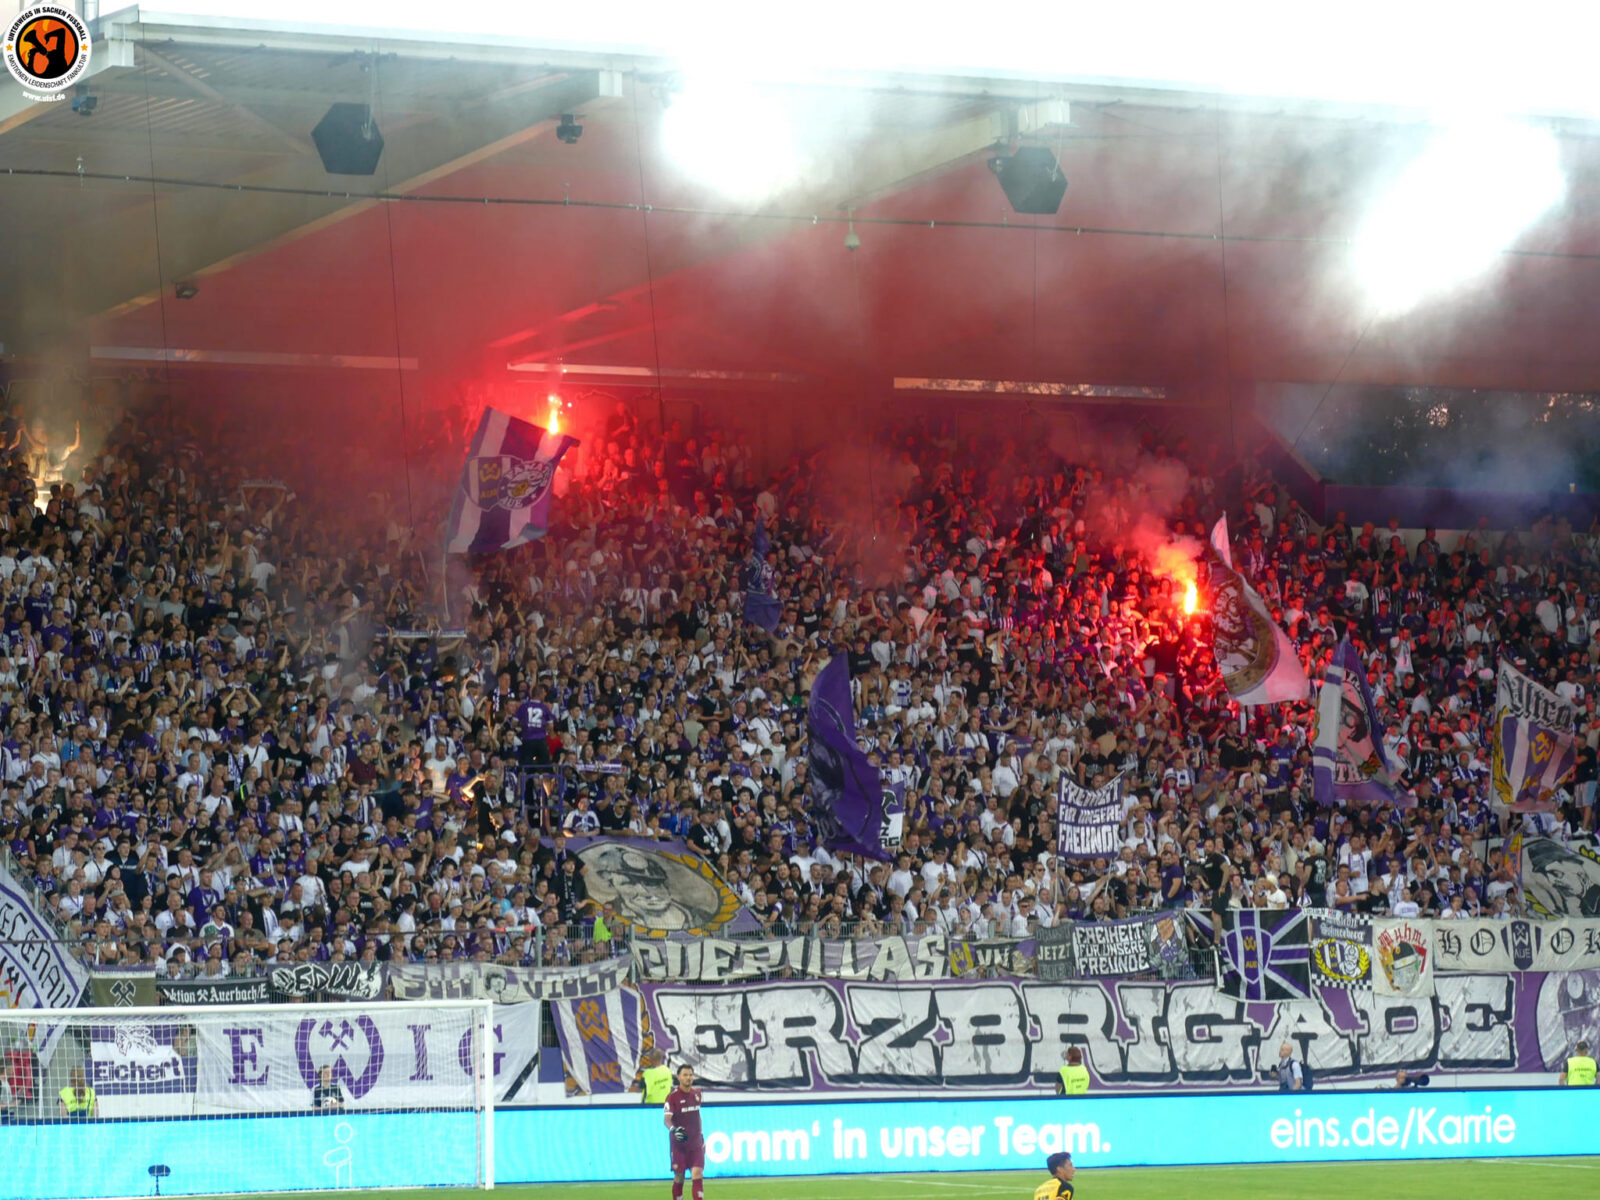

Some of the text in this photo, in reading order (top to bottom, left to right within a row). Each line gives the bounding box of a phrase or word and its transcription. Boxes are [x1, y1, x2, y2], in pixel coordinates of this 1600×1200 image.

[527, 707, 543, 723] 12
[1075, 921, 1144, 945] FREIHEIT
[1038, 942, 1072, 961] JETZT
[1102, 939, 1147, 956] UNSERE
[1514, 948, 1531, 958] AUE
[1078, 952, 1150, 977] FREUNDE
[653, 975, 1517, 1089] ERZBRIGADE
[94, 1056, 181, 1082] Eichert
[591, 1062, 621, 1082] AUE
[705, 1116, 1112, 1163] omm' in unser Team.
[1270, 1105, 1516, 1150] eins.de/Karrie
